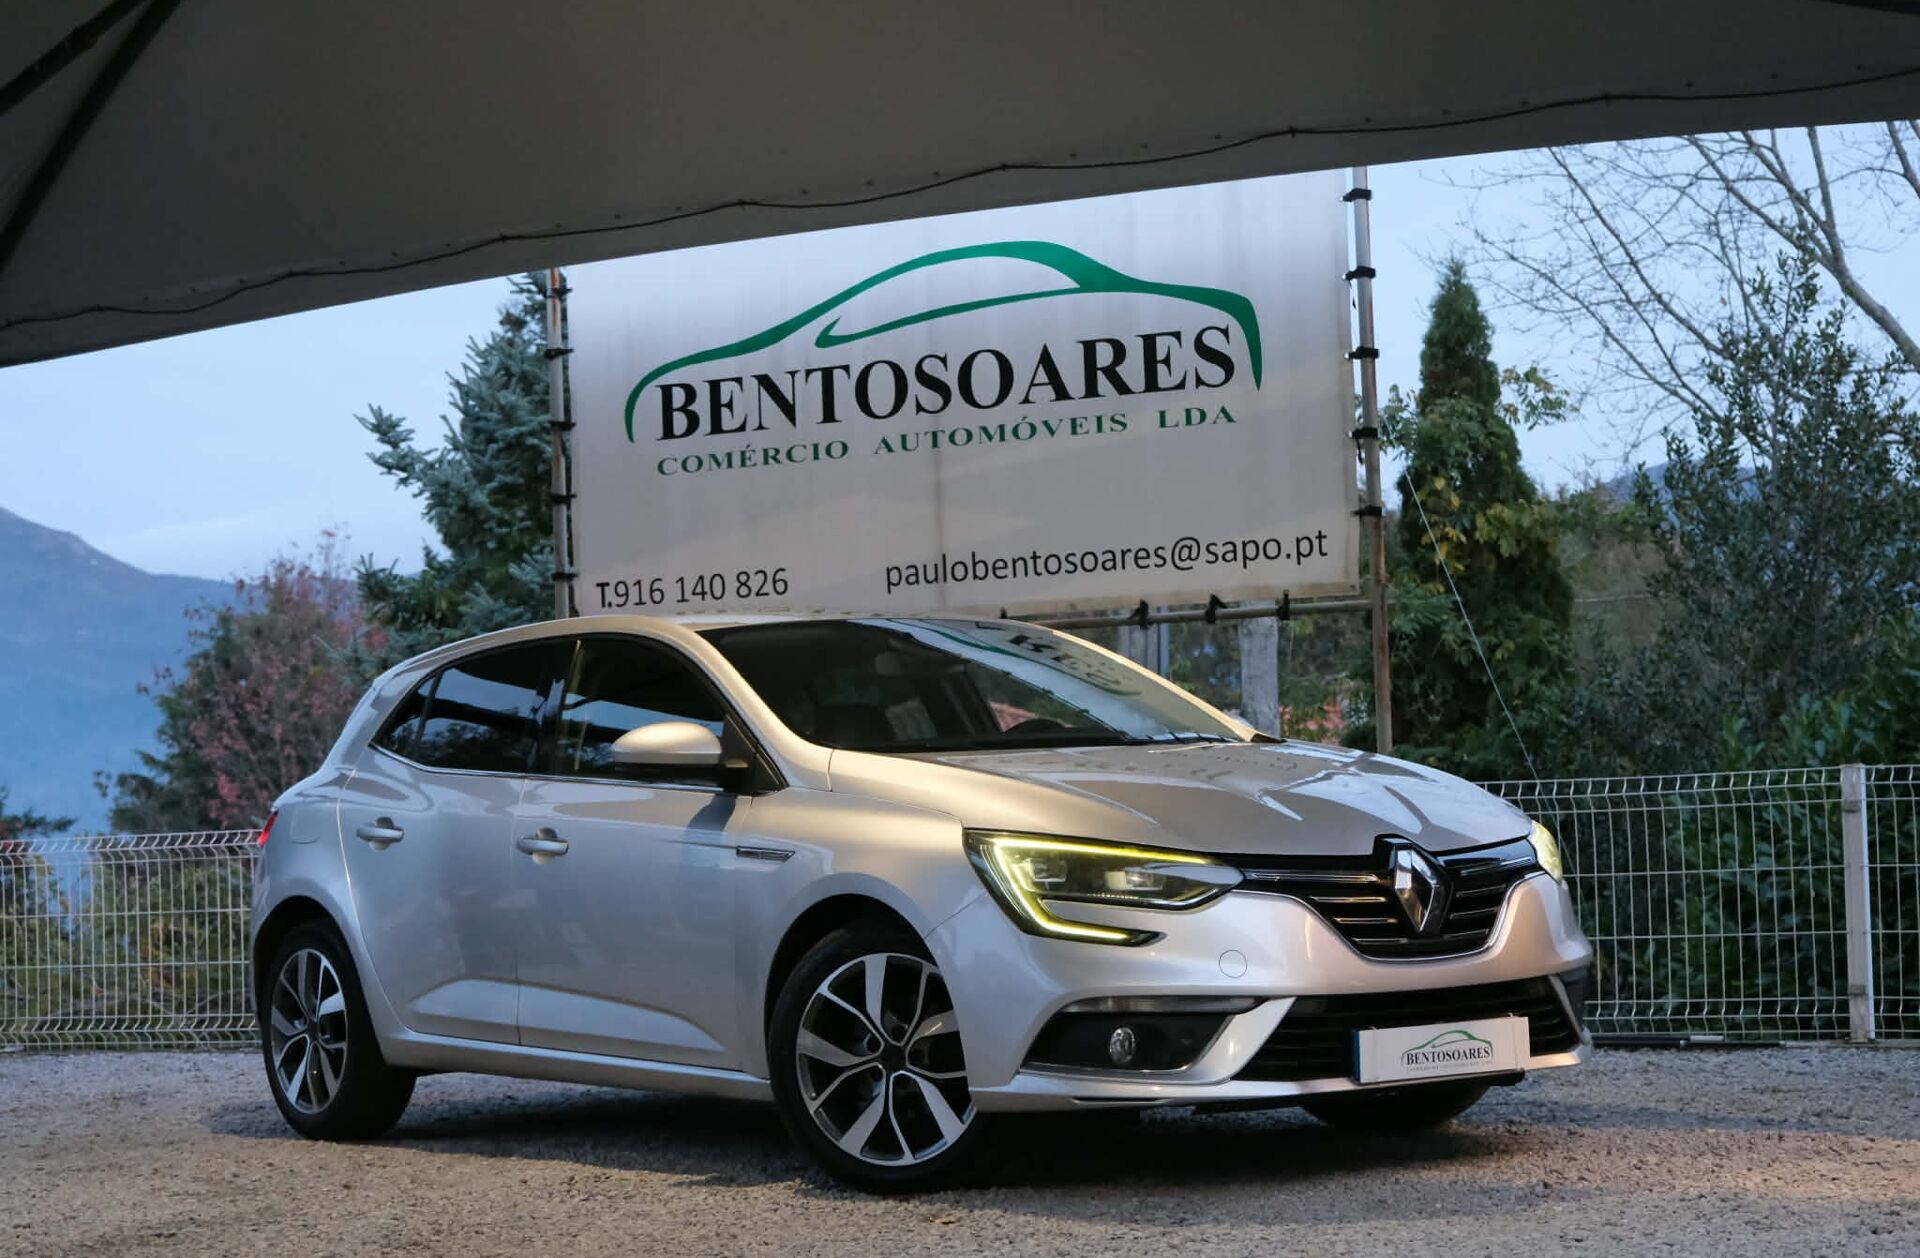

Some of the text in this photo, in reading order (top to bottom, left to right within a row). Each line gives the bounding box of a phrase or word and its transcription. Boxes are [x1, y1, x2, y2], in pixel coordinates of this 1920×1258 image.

[655, 324, 1236, 441] BENTOSOARES
[656, 405, 1237, 477] COMÉRCIO AUTOMÓVEIS LDA
[595, 567, 789, 609] T.916 140 826
[885, 529, 1329, 595] paulobentosoares@sapo.pt
[1407, 1047, 1490, 1065] BENTOSOARES
